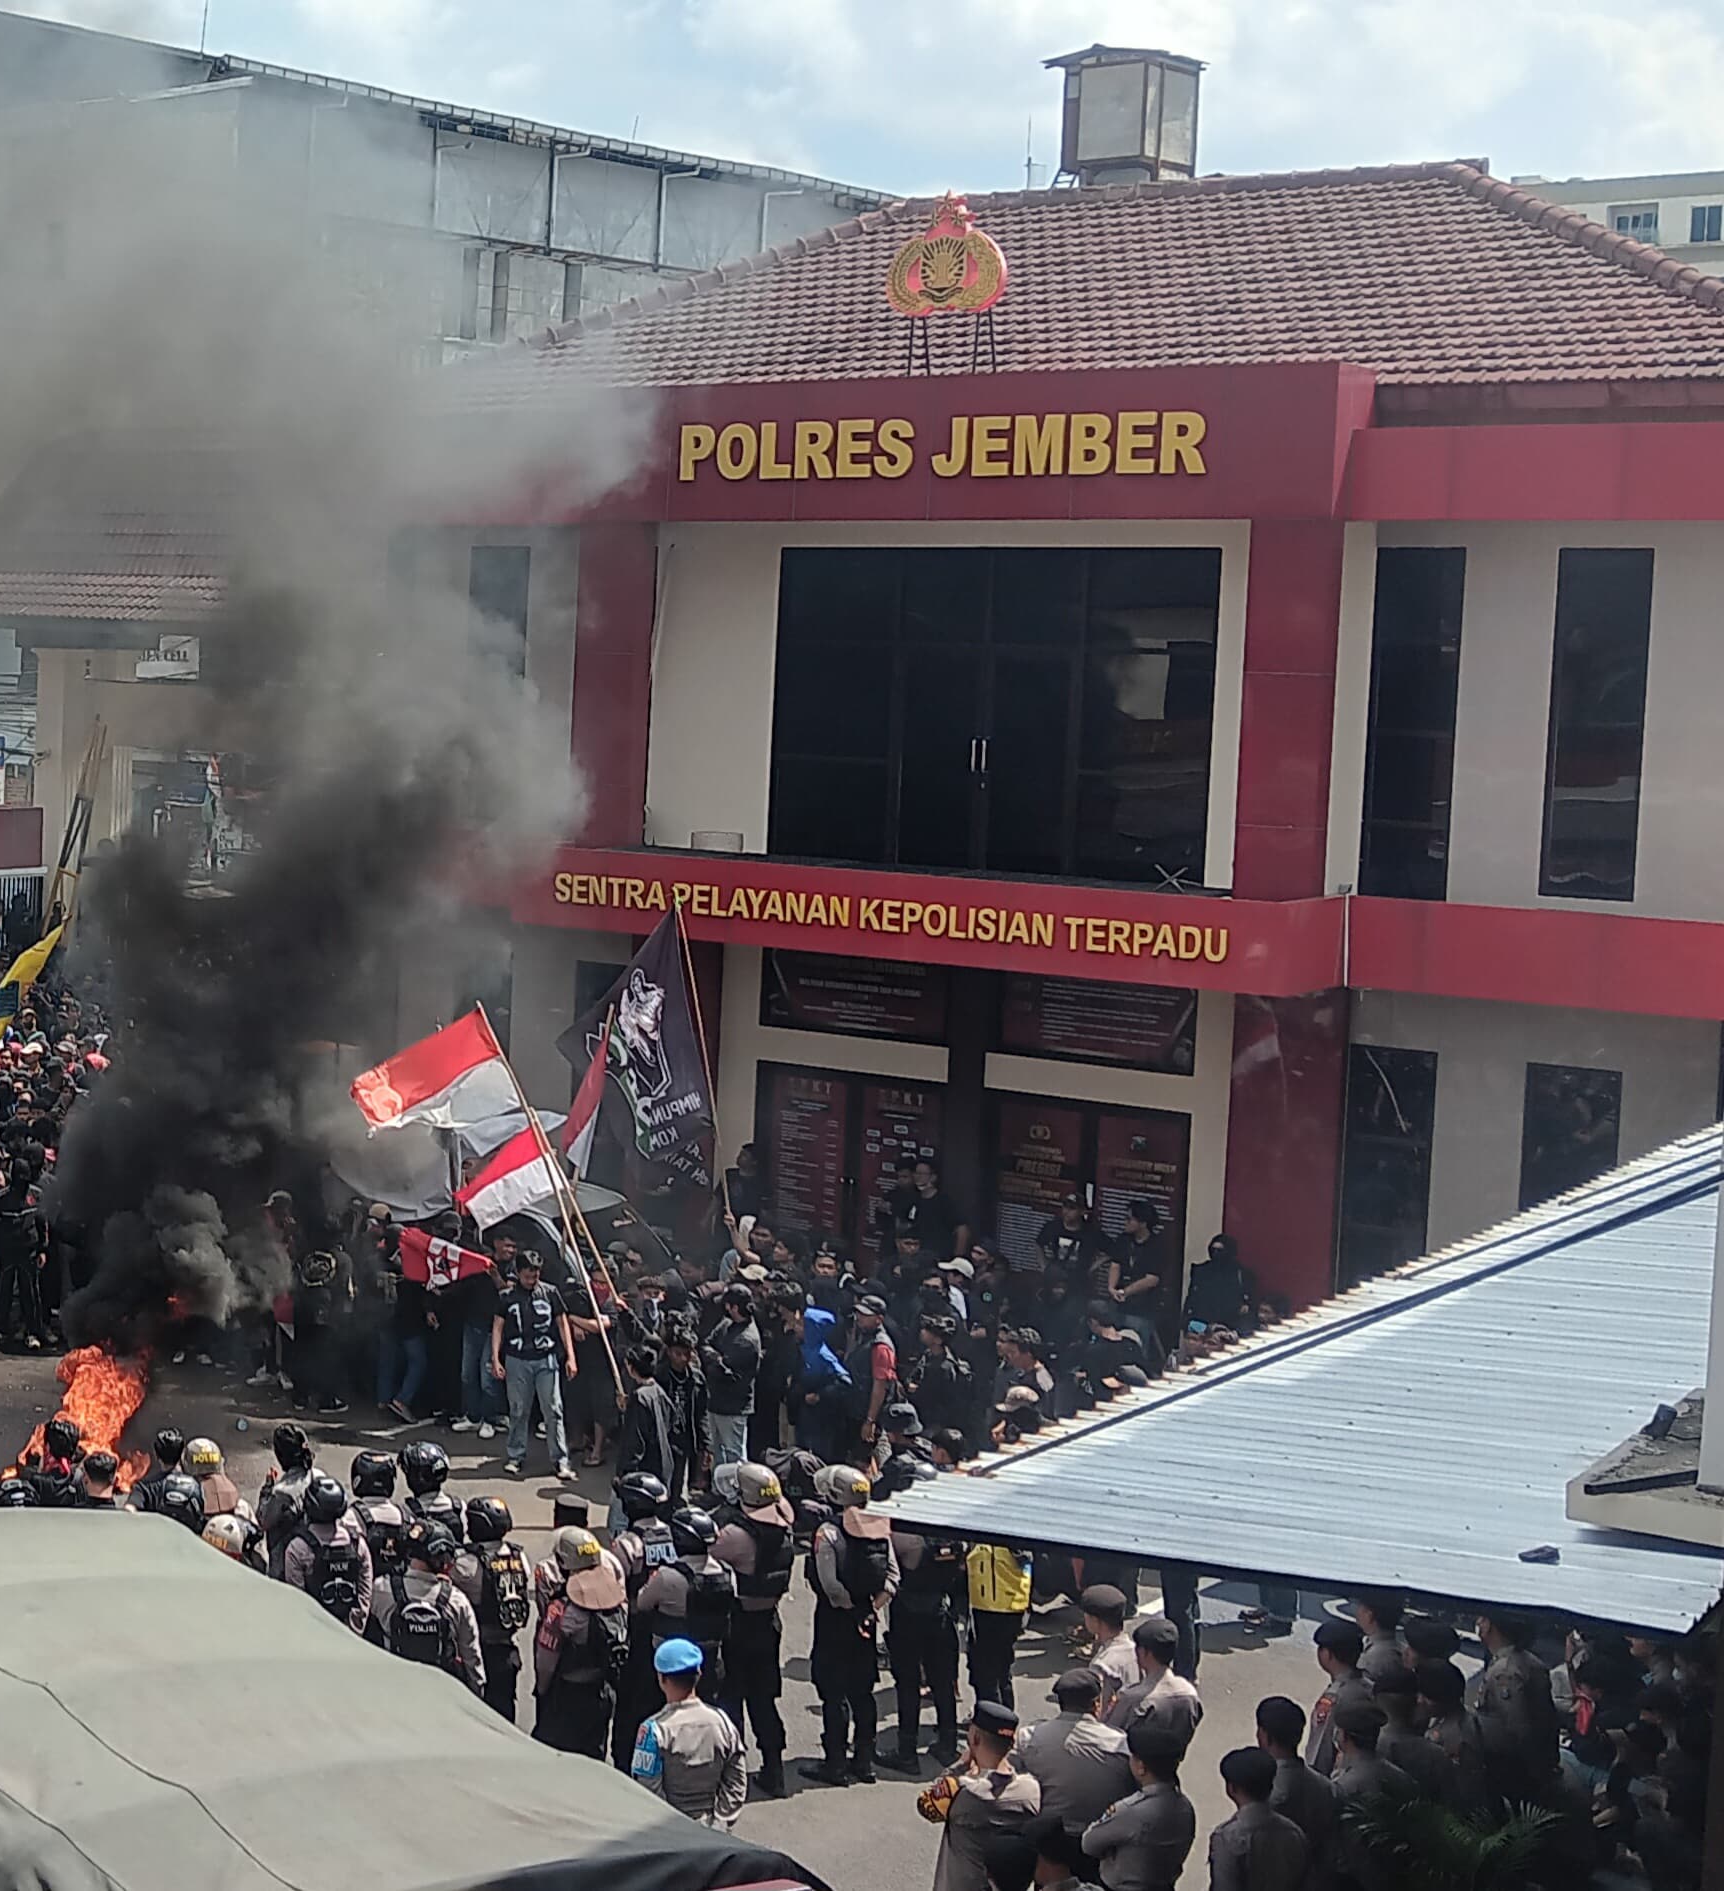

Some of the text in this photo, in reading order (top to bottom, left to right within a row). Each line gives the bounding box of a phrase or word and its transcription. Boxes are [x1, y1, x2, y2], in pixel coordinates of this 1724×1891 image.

[678, 411, 1208, 482] POLRES JEMBER
[554, 872, 1228, 963] SENTRA PELAYANAN KEPOLISIAN TERPADU
